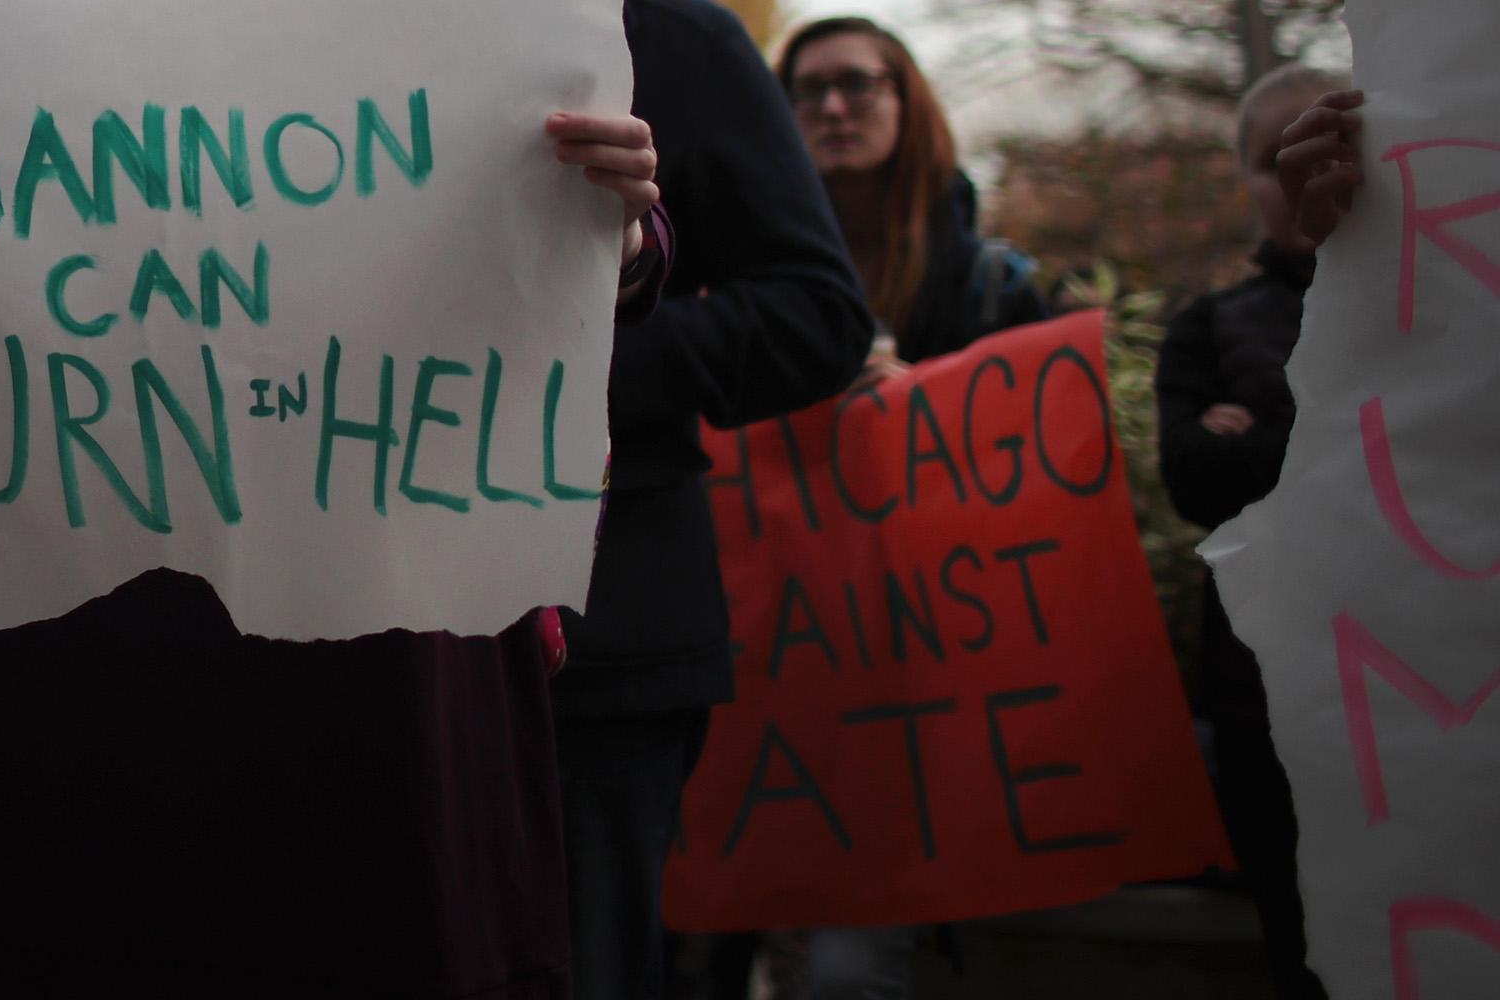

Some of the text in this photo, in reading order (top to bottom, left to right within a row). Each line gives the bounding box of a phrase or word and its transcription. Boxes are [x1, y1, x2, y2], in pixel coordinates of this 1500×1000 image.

[46, 242, 270, 337] CAN
[248, 372, 307, 422] IN
[315, 336, 604, 515] HELL
[703, 343, 1114, 541] HICAGO
[674, 684, 1136, 862] ATE
